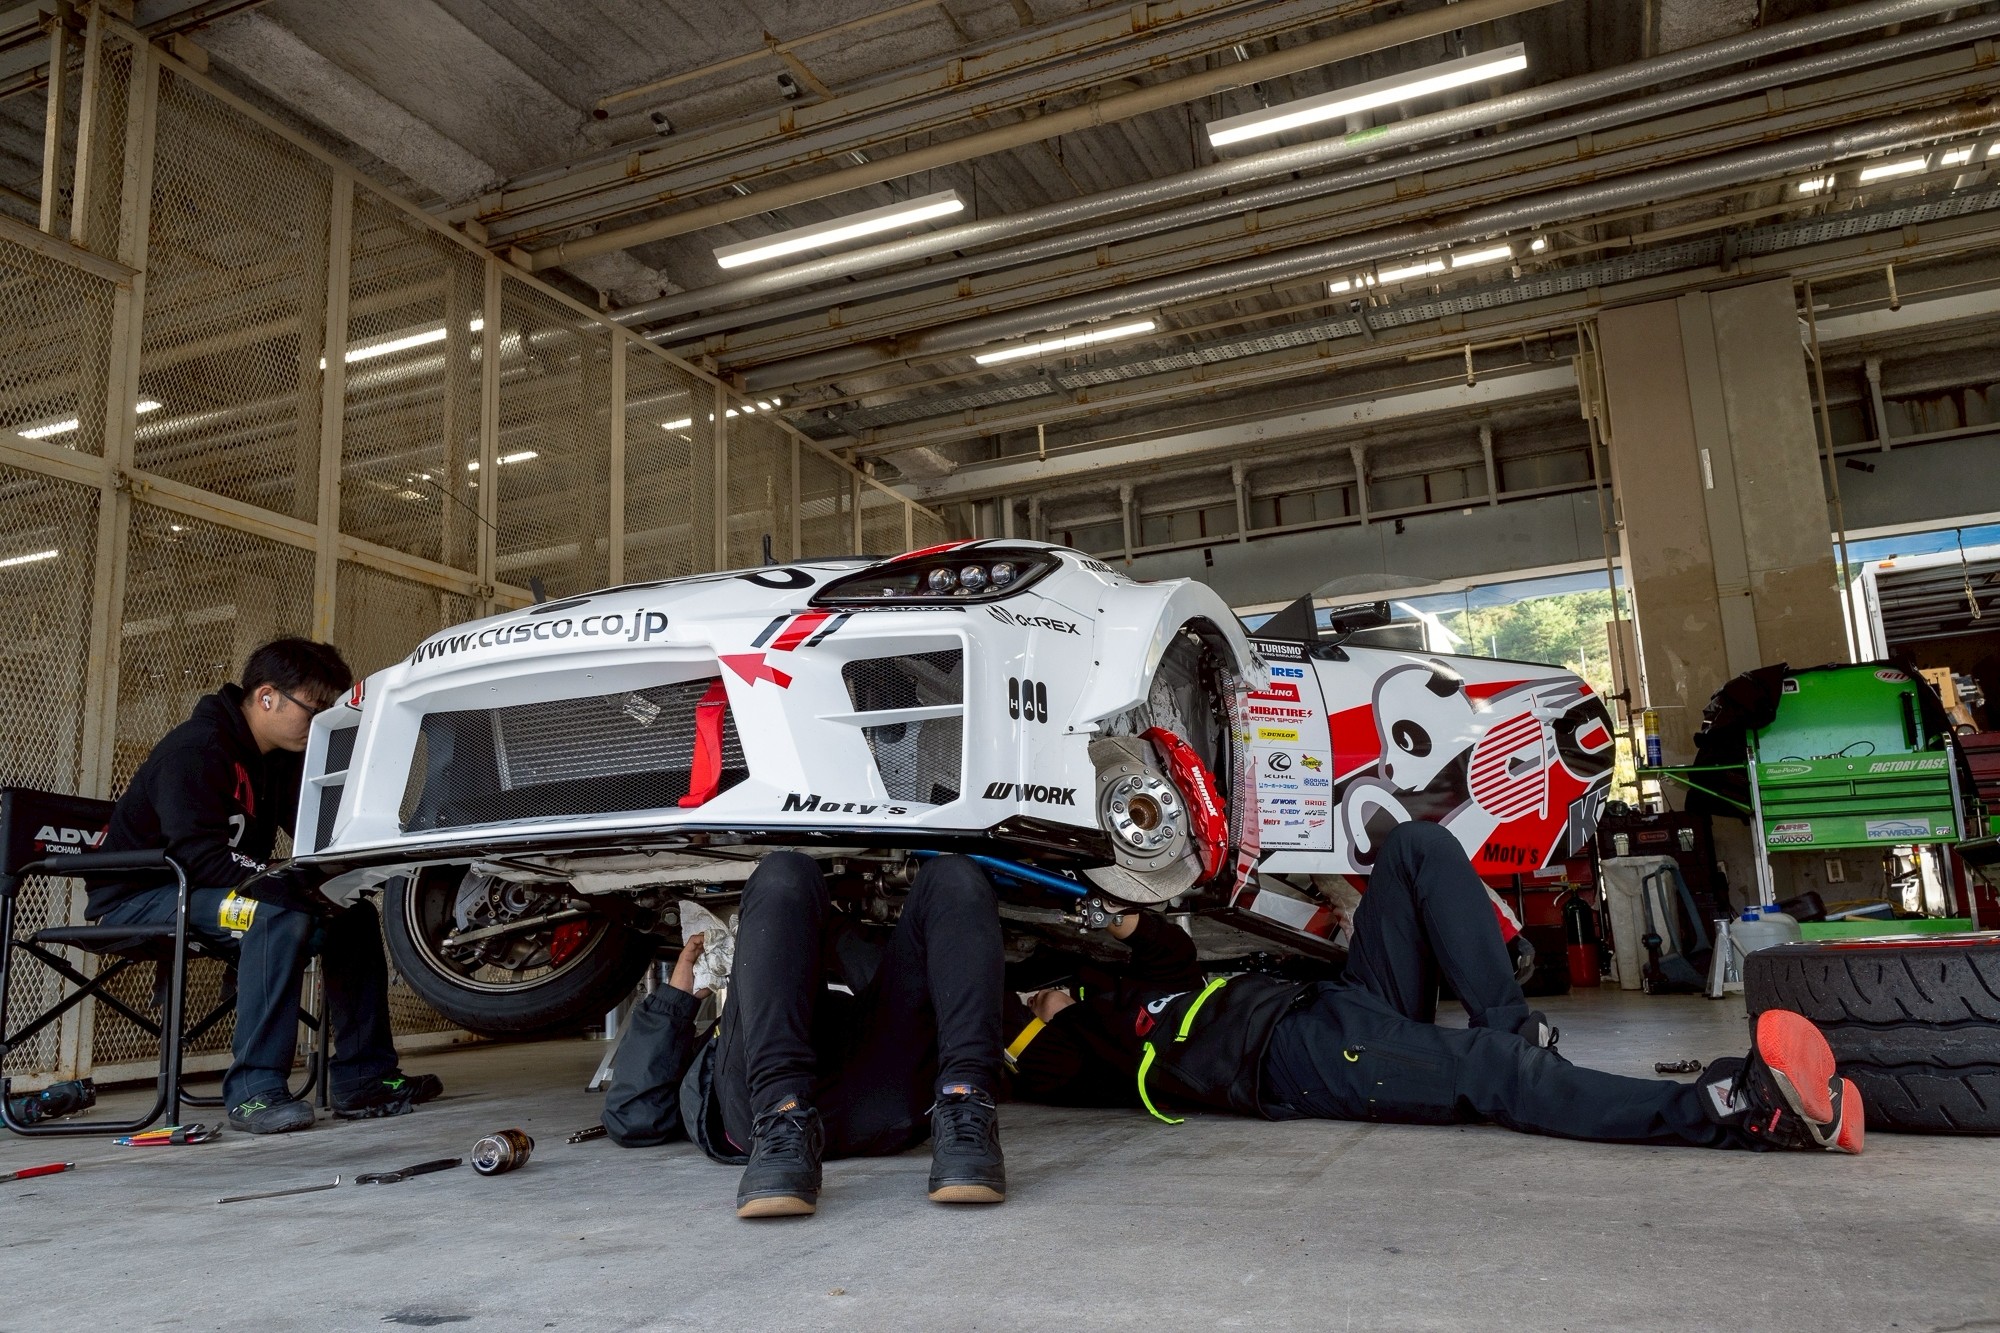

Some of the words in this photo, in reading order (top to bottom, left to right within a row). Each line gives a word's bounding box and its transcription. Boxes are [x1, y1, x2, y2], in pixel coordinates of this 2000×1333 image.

[1259, 643, 1302, 655] TURISMO
[1271, 667, 1304, 678] IRES
[1249, 706, 1307, 718] HIBATIRE
[1869, 760, 1918, 773] FACTORY
[1917, 758, 1947, 770] BASE
[1015, 784, 1077, 806] WORK
[1191, 765, 1219, 817] Winmax
[781, 793, 907, 814] Moty's
[34, 825, 108, 846] ADV
[45, 844, 82, 855] YOKOHAMA
[1483, 843, 1539, 865] Moty's
